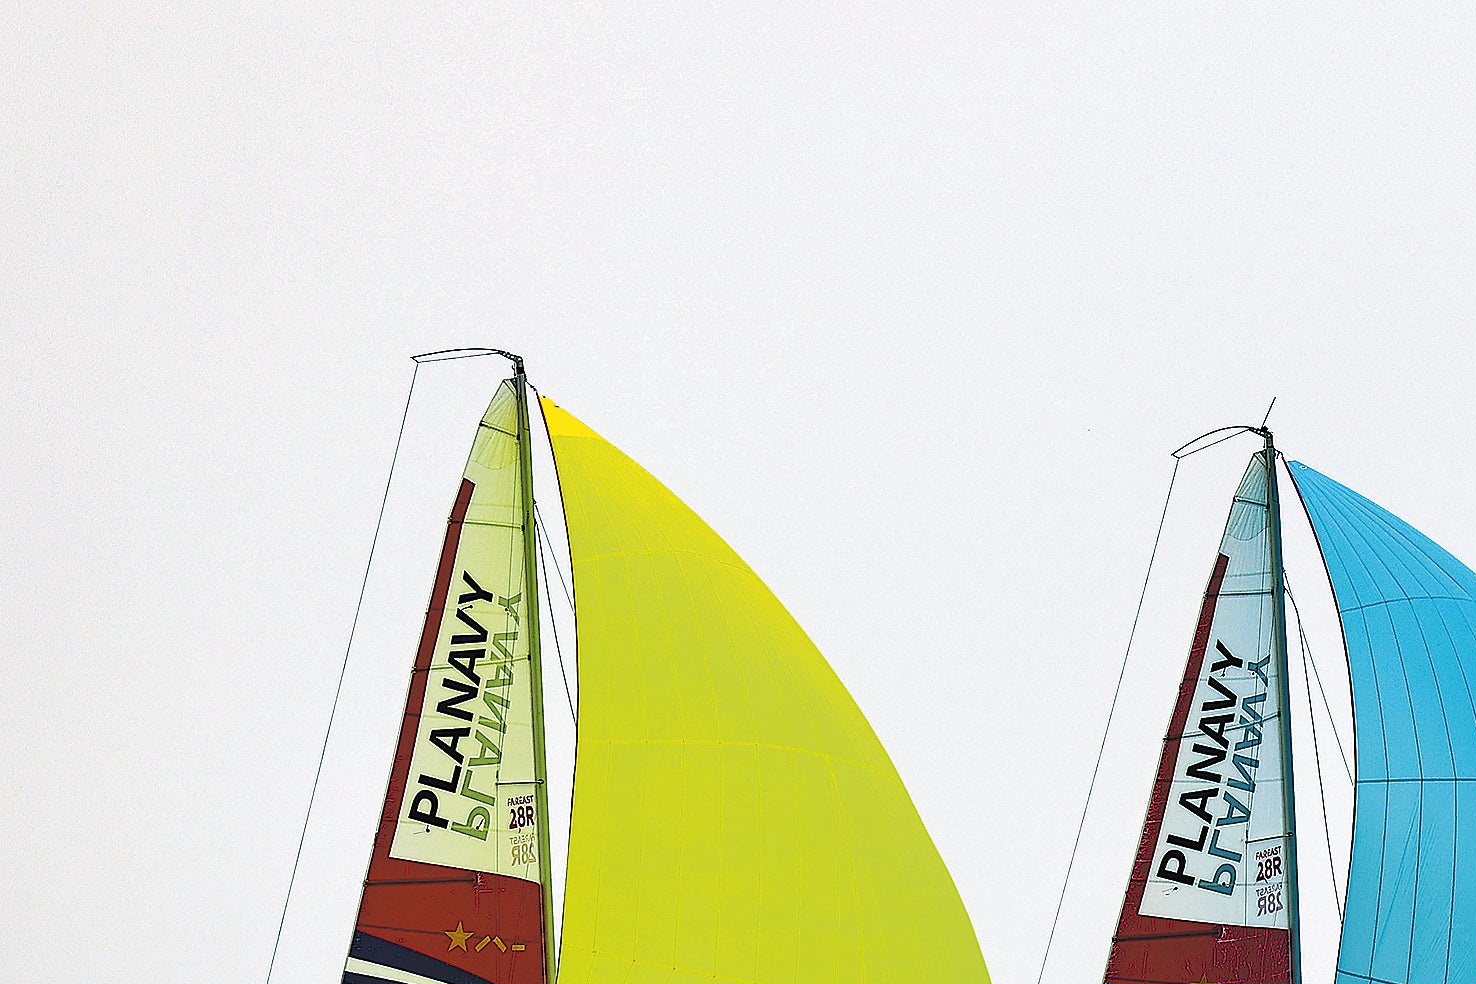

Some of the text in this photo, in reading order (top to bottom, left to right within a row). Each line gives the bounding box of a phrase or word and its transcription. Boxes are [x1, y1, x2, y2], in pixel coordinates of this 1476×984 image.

[408, 569, 494, 830] PLANAVY
[1156, 639, 1243, 887] PLANAVY
[507, 794, 534, 807] FAREAST
[509, 805, 535, 829] 28R
[1255, 845, 1282, 861] FAREAST
[1256, 856, 1282, 882] 28R
